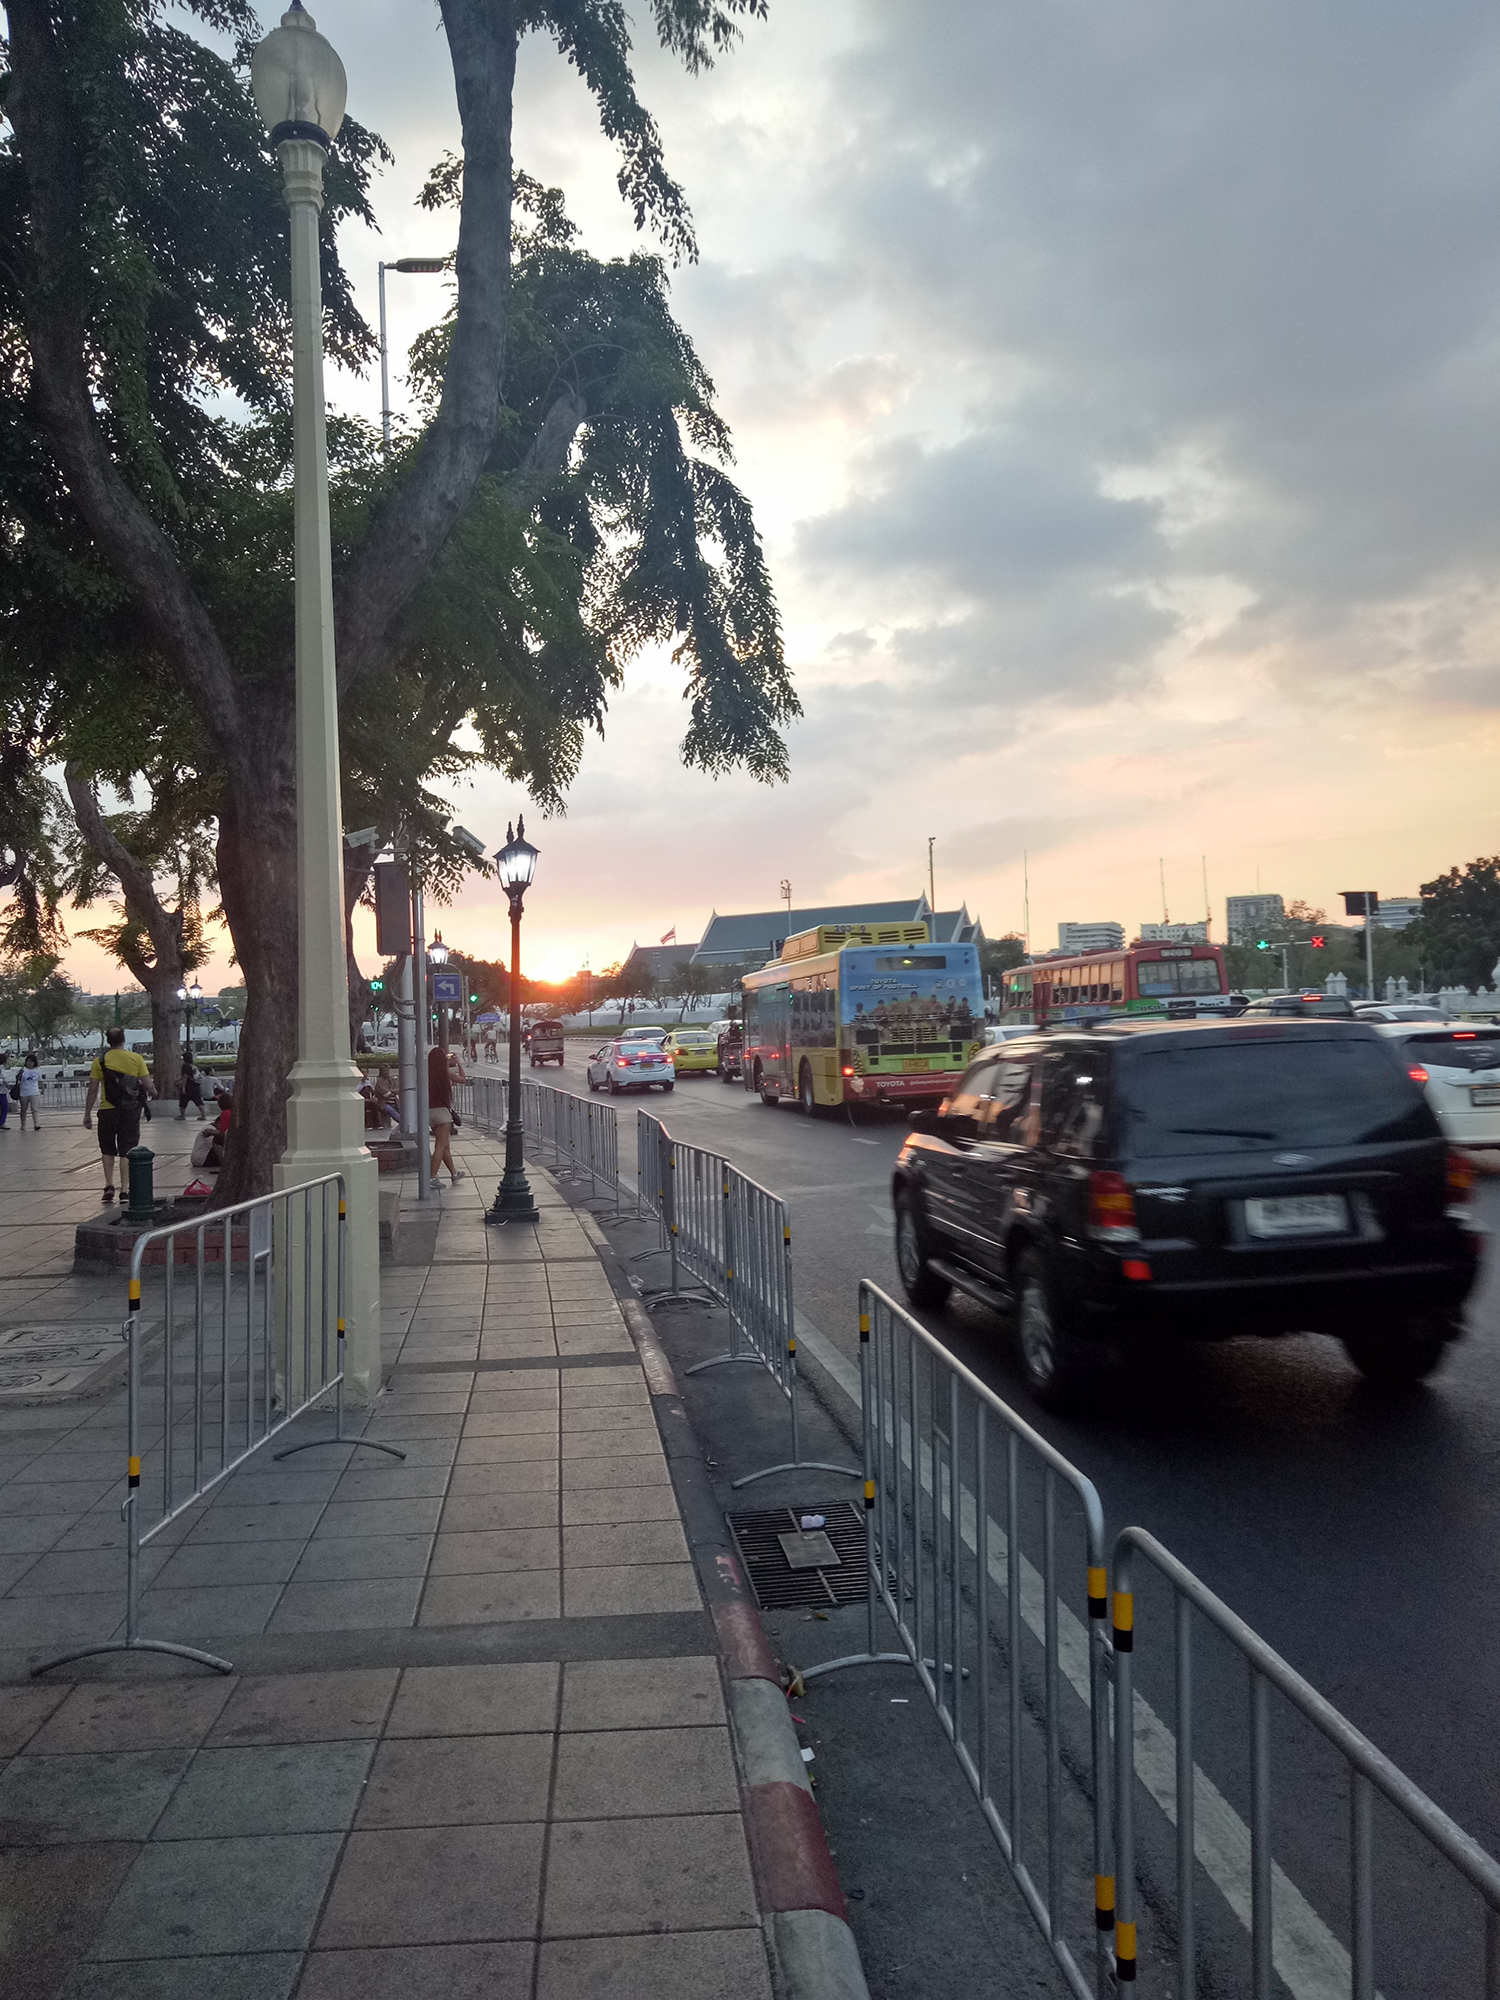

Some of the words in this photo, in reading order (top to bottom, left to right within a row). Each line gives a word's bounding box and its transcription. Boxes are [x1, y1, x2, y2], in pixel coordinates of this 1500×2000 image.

[370, 981, 383, 990] 104
[882, 983, 919, 991] FOOTBALL
[876, 1080, 905, 1088] TOYOTA
